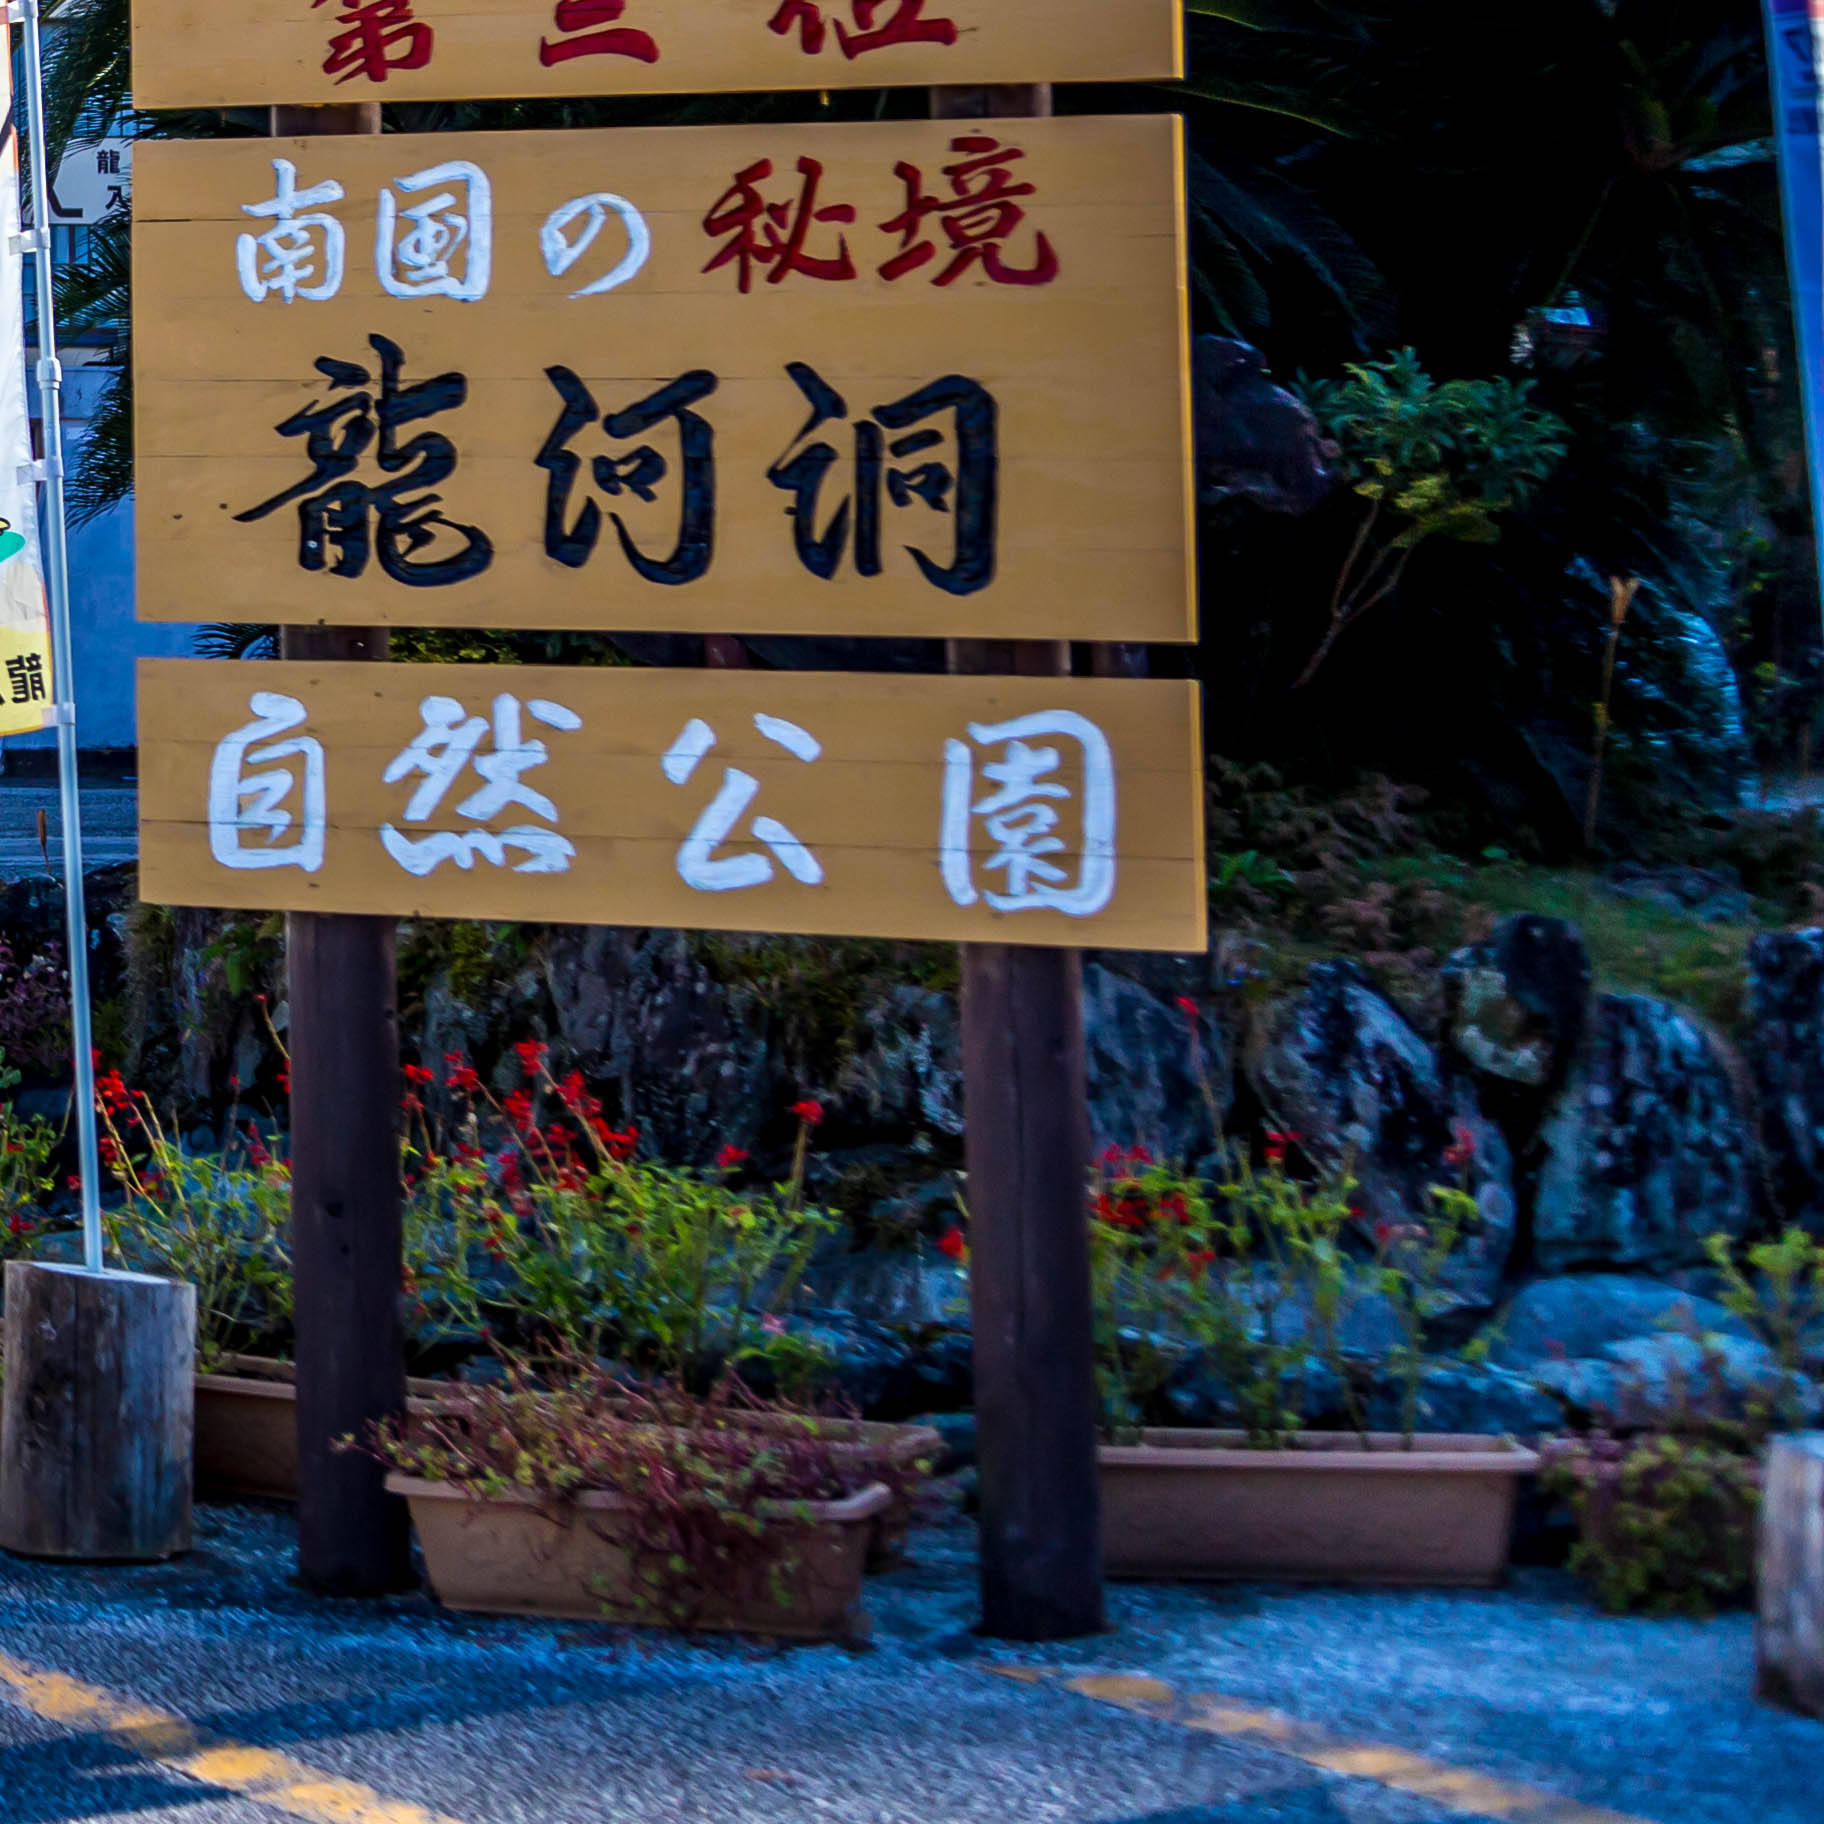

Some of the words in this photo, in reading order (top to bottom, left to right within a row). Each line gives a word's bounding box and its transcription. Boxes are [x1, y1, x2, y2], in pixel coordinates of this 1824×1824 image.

[236, 135, 1061, 304] 南国の秘境
[232, 333, 1005, 596] 龍河洞
[206, 689, 1118, 920] 自然公園
